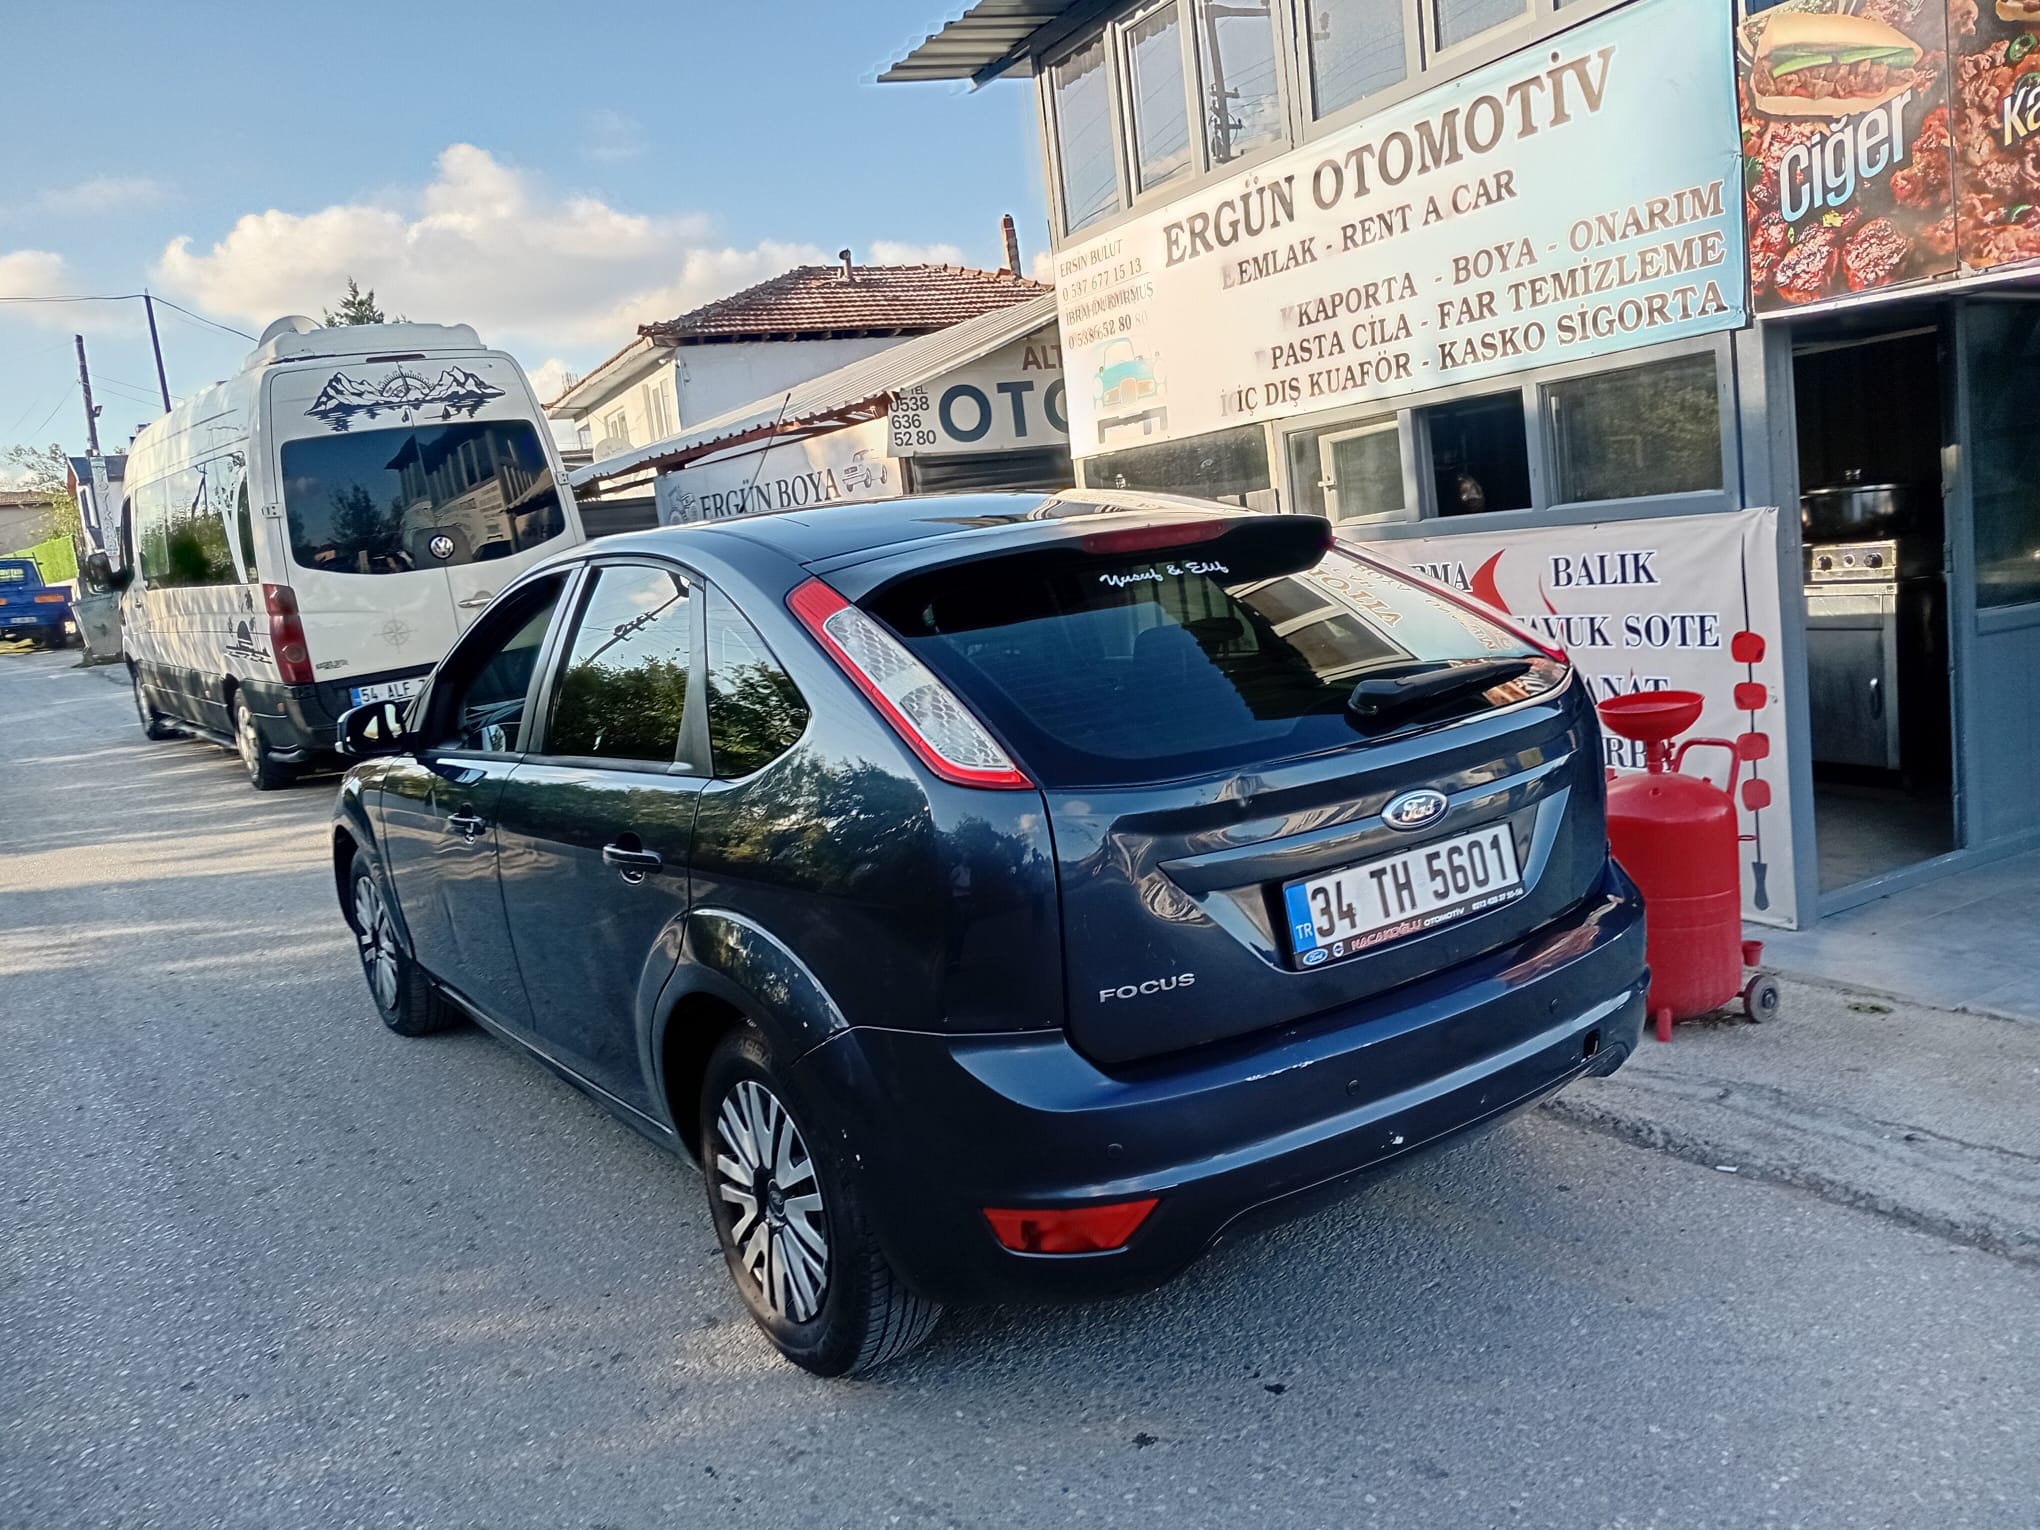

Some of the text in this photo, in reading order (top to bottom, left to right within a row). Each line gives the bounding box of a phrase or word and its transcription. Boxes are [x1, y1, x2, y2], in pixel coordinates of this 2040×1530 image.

[1162, 46, 1616, 268] ERGÜN OTOMOTİV
[1236, 237, 1318, 286] EMLAK
[1341, 204, 1412, 252] RENT
[1422, 196, 1443, 226] A
[1452, 170, 1517, 215] CAR
[1114, 263, 1126, 281] 15
[1129, 257, 1142, 275] 13
[1298, 271, 1418, 328] KAPORTA
[1452, 237, 1537, 285] BOYA
[1569, 181, 1725, 251] ONARIM
[1271, 330, 1345, 370] PASTA
[1352, 313, 1413, 350] CİLA
[1438, 290, 1498, 330] FAR
[1507, 230, 1727, 312] TEMİZLEME
[1308, 350, 1413, 398] KUAFÖR
[1438, 321, 1546, 370] KASKO
[1557, 280, 1729, 345] SİGORTA
[889, 395, 929, 412] 0538
[891, 413, 922, 430] 636
[894, 429, 937, 447] 52 80
[699, 468, 842, 520] ERGÜN BOYA
[1166, 564, 1184, 576] &
[1411, 561, 1472, 591] MA
[1551, 551, 1658, 587] BALIK
[1625, 615, 1720, 647] SOTE
[360, 681, 411, 702] 54 ALF
[1310, 833, 1508, 938] 34 TH 5601
[1295, 922, 1314, 940] TR
[1099, 973, 1196, 1003] FOCUS
